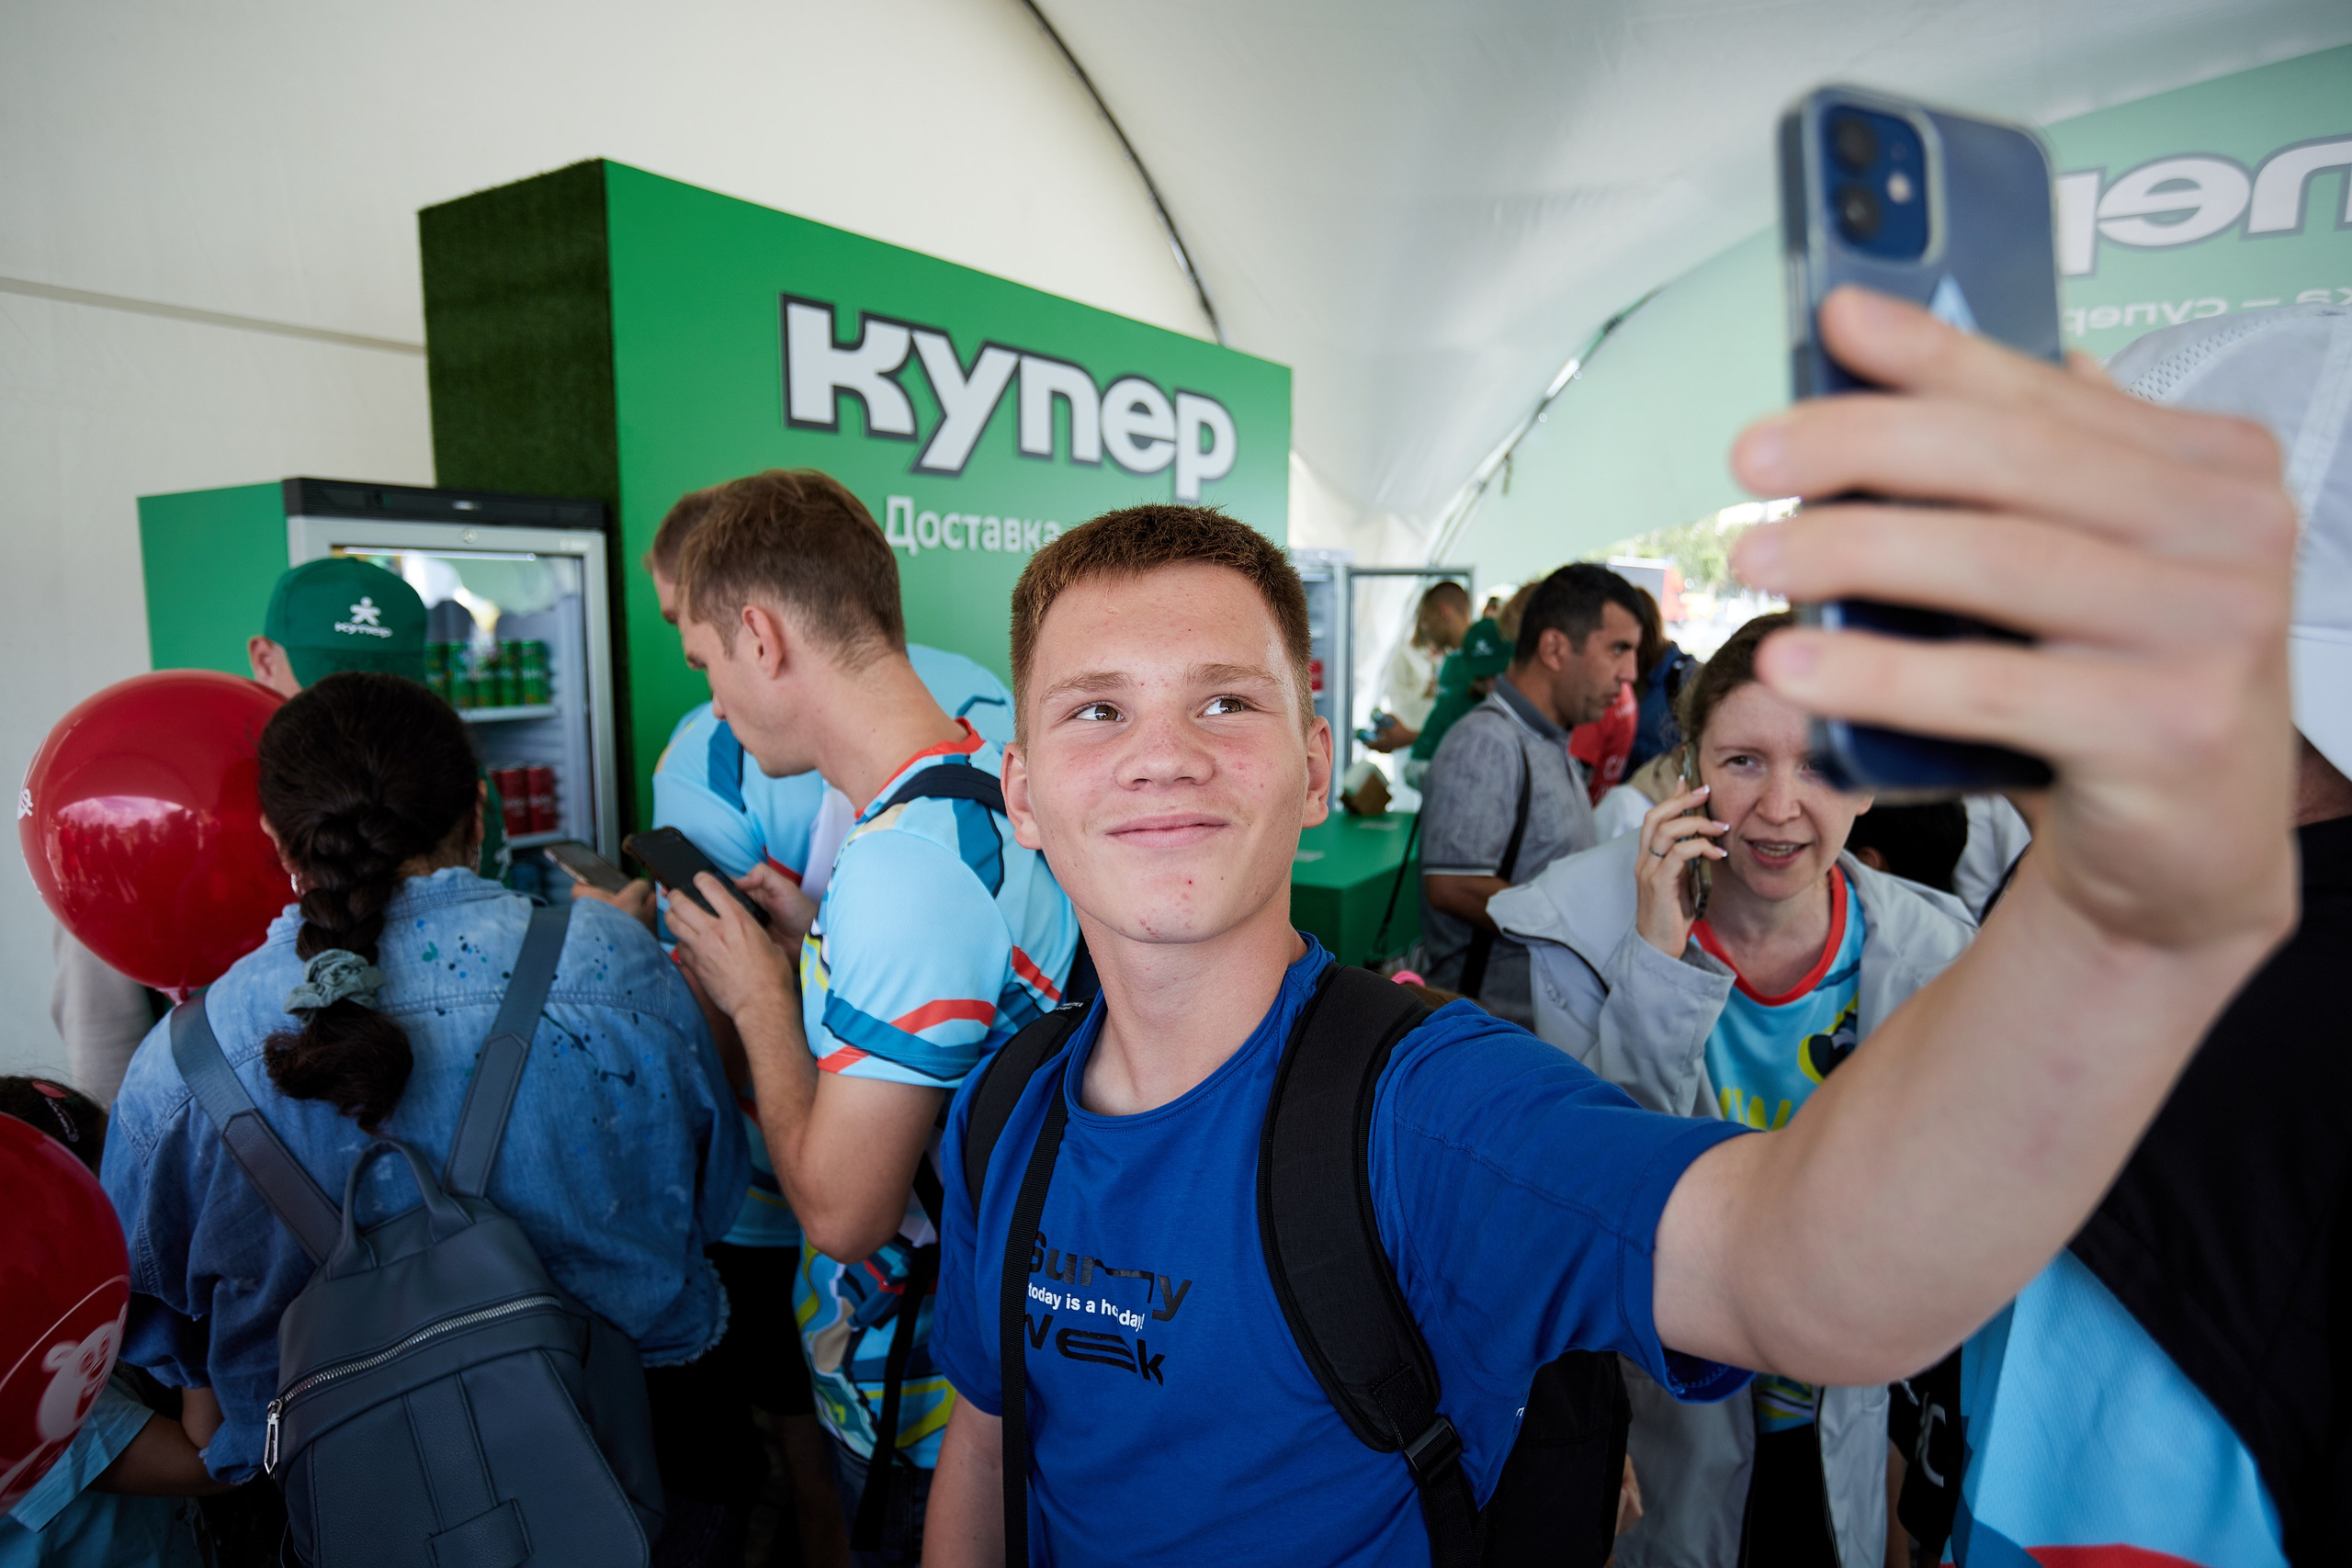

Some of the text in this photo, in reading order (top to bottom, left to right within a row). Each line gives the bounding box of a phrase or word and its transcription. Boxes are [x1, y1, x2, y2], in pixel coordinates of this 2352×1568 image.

[884, 494, 1061, 557] Доставка
[1027, 1282, 1061, 1310] today
[1066, 1293, 1080, 1311] is
[1085, 1300, 1095, 1314] a
